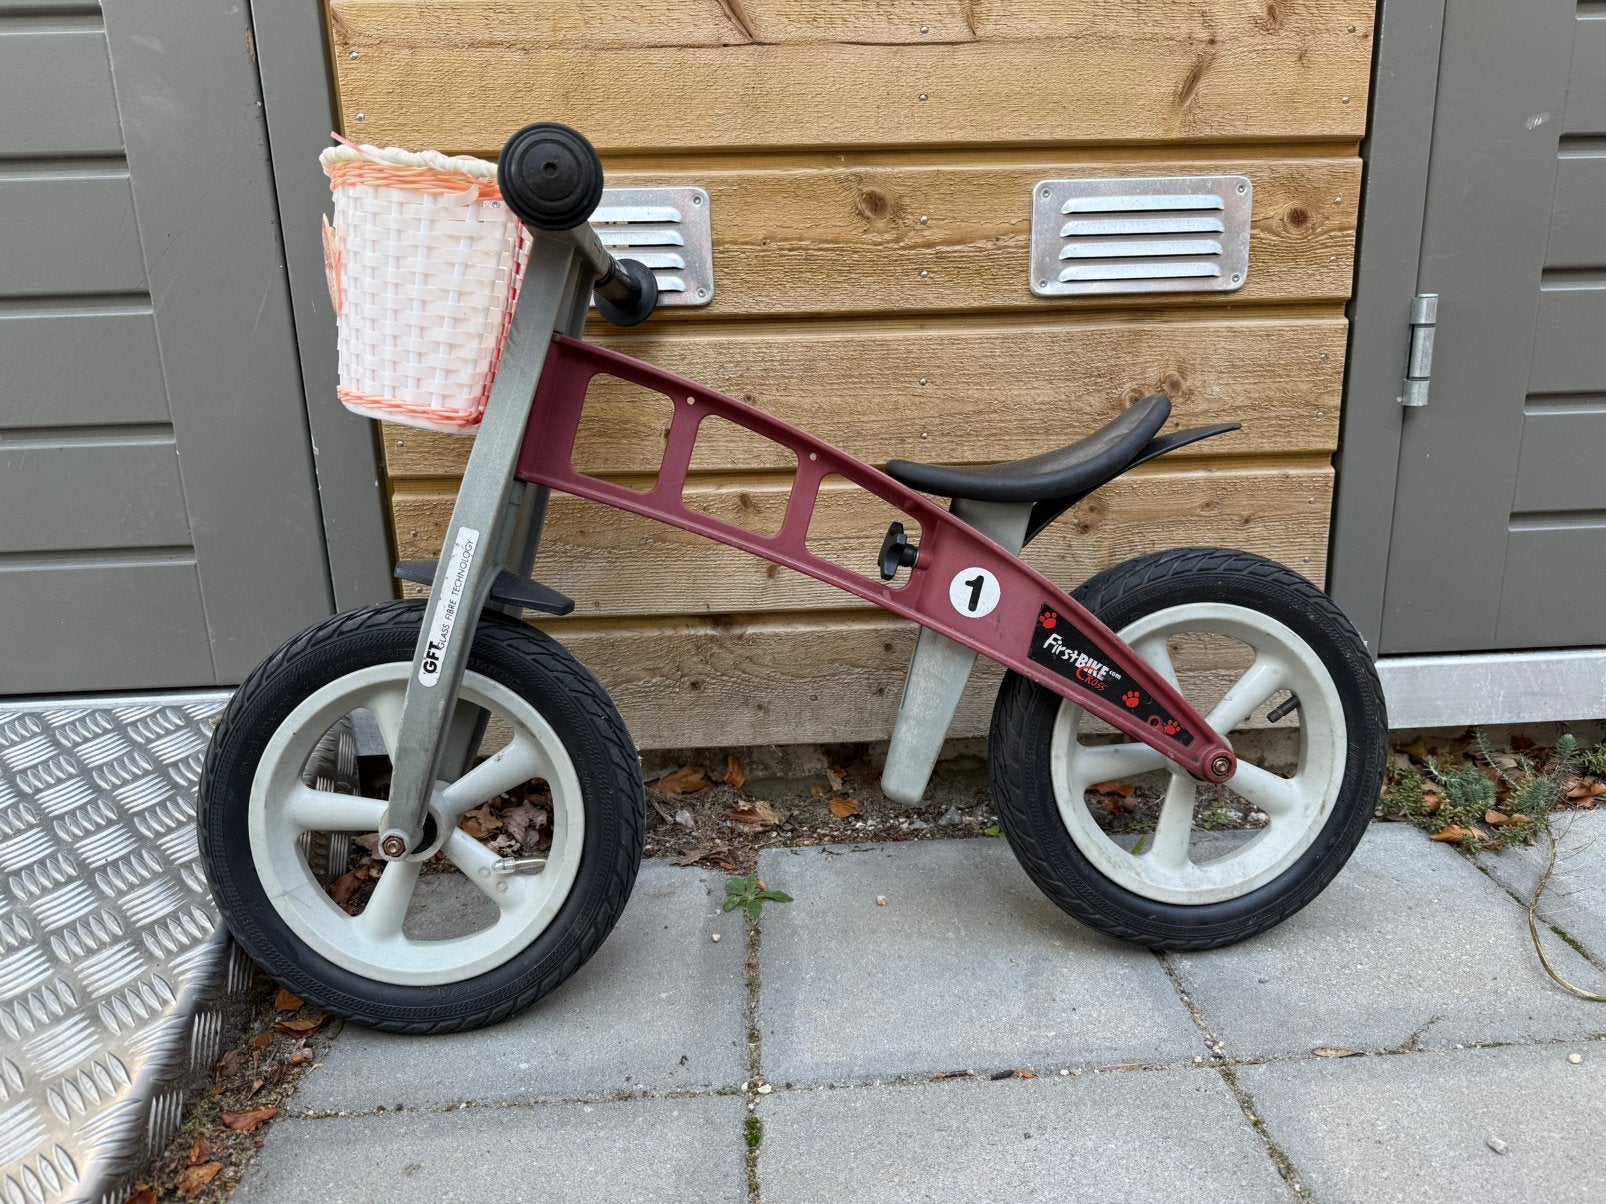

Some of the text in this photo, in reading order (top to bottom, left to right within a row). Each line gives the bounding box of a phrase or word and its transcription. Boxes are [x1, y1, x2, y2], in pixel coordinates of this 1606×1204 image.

[437, 539, 474, 650] GLASS FIBRE TECHNOLOGY
[964, 574, 985, 612] 1
[423, 640, 441, 674] GFT
